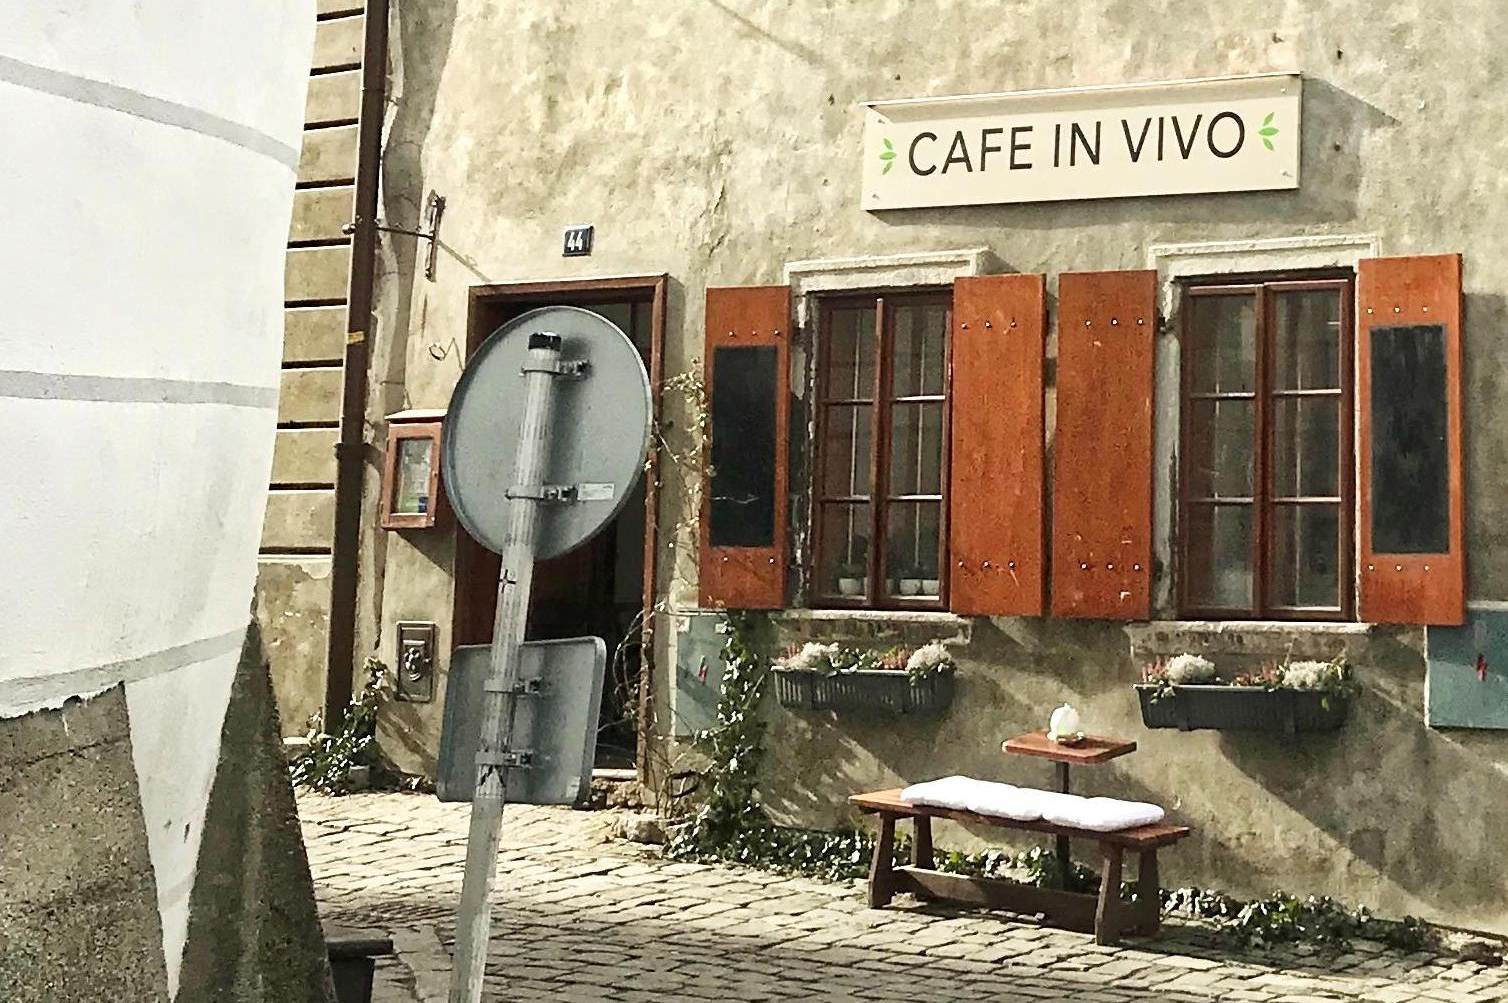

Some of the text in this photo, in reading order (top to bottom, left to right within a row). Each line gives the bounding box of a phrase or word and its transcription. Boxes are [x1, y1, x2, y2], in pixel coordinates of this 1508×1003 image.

[908, 111, 1245, 176] CAFE IN VIVO
[567, 231, 583, 251] 44
